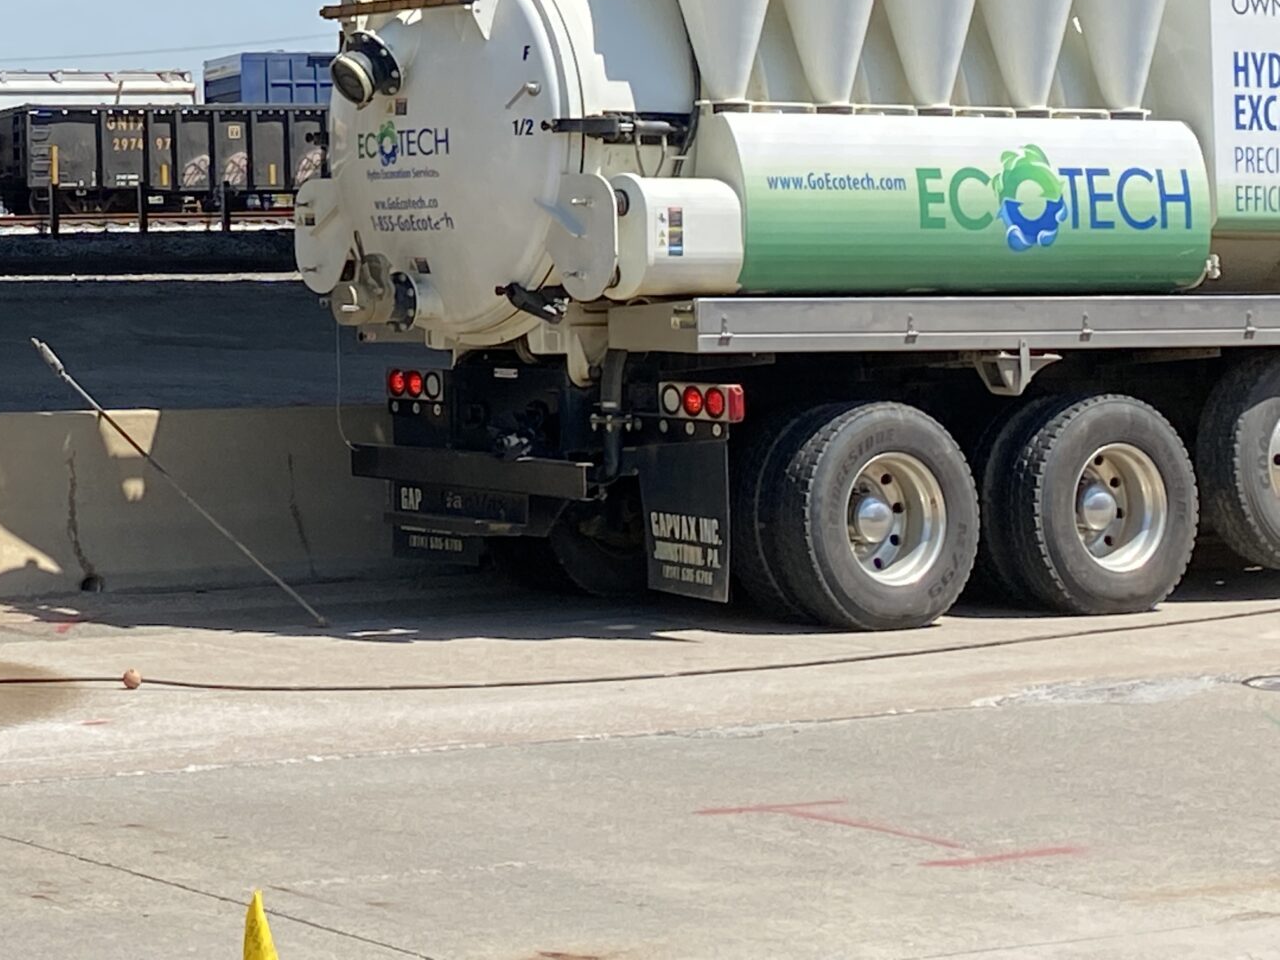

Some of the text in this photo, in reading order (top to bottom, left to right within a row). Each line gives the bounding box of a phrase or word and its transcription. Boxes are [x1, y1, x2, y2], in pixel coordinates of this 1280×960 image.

[522, 44, 531, 61] F
[1233, 51, 1280, 88] HYD
[357, 123, 450, 164] ECOTECH
[512, 118, 534, 136] 1/2
[766, 152, 1193, 245] www.GoEcotech.com ECOTECH
[650, 511, 697, 542] GAPVAX
